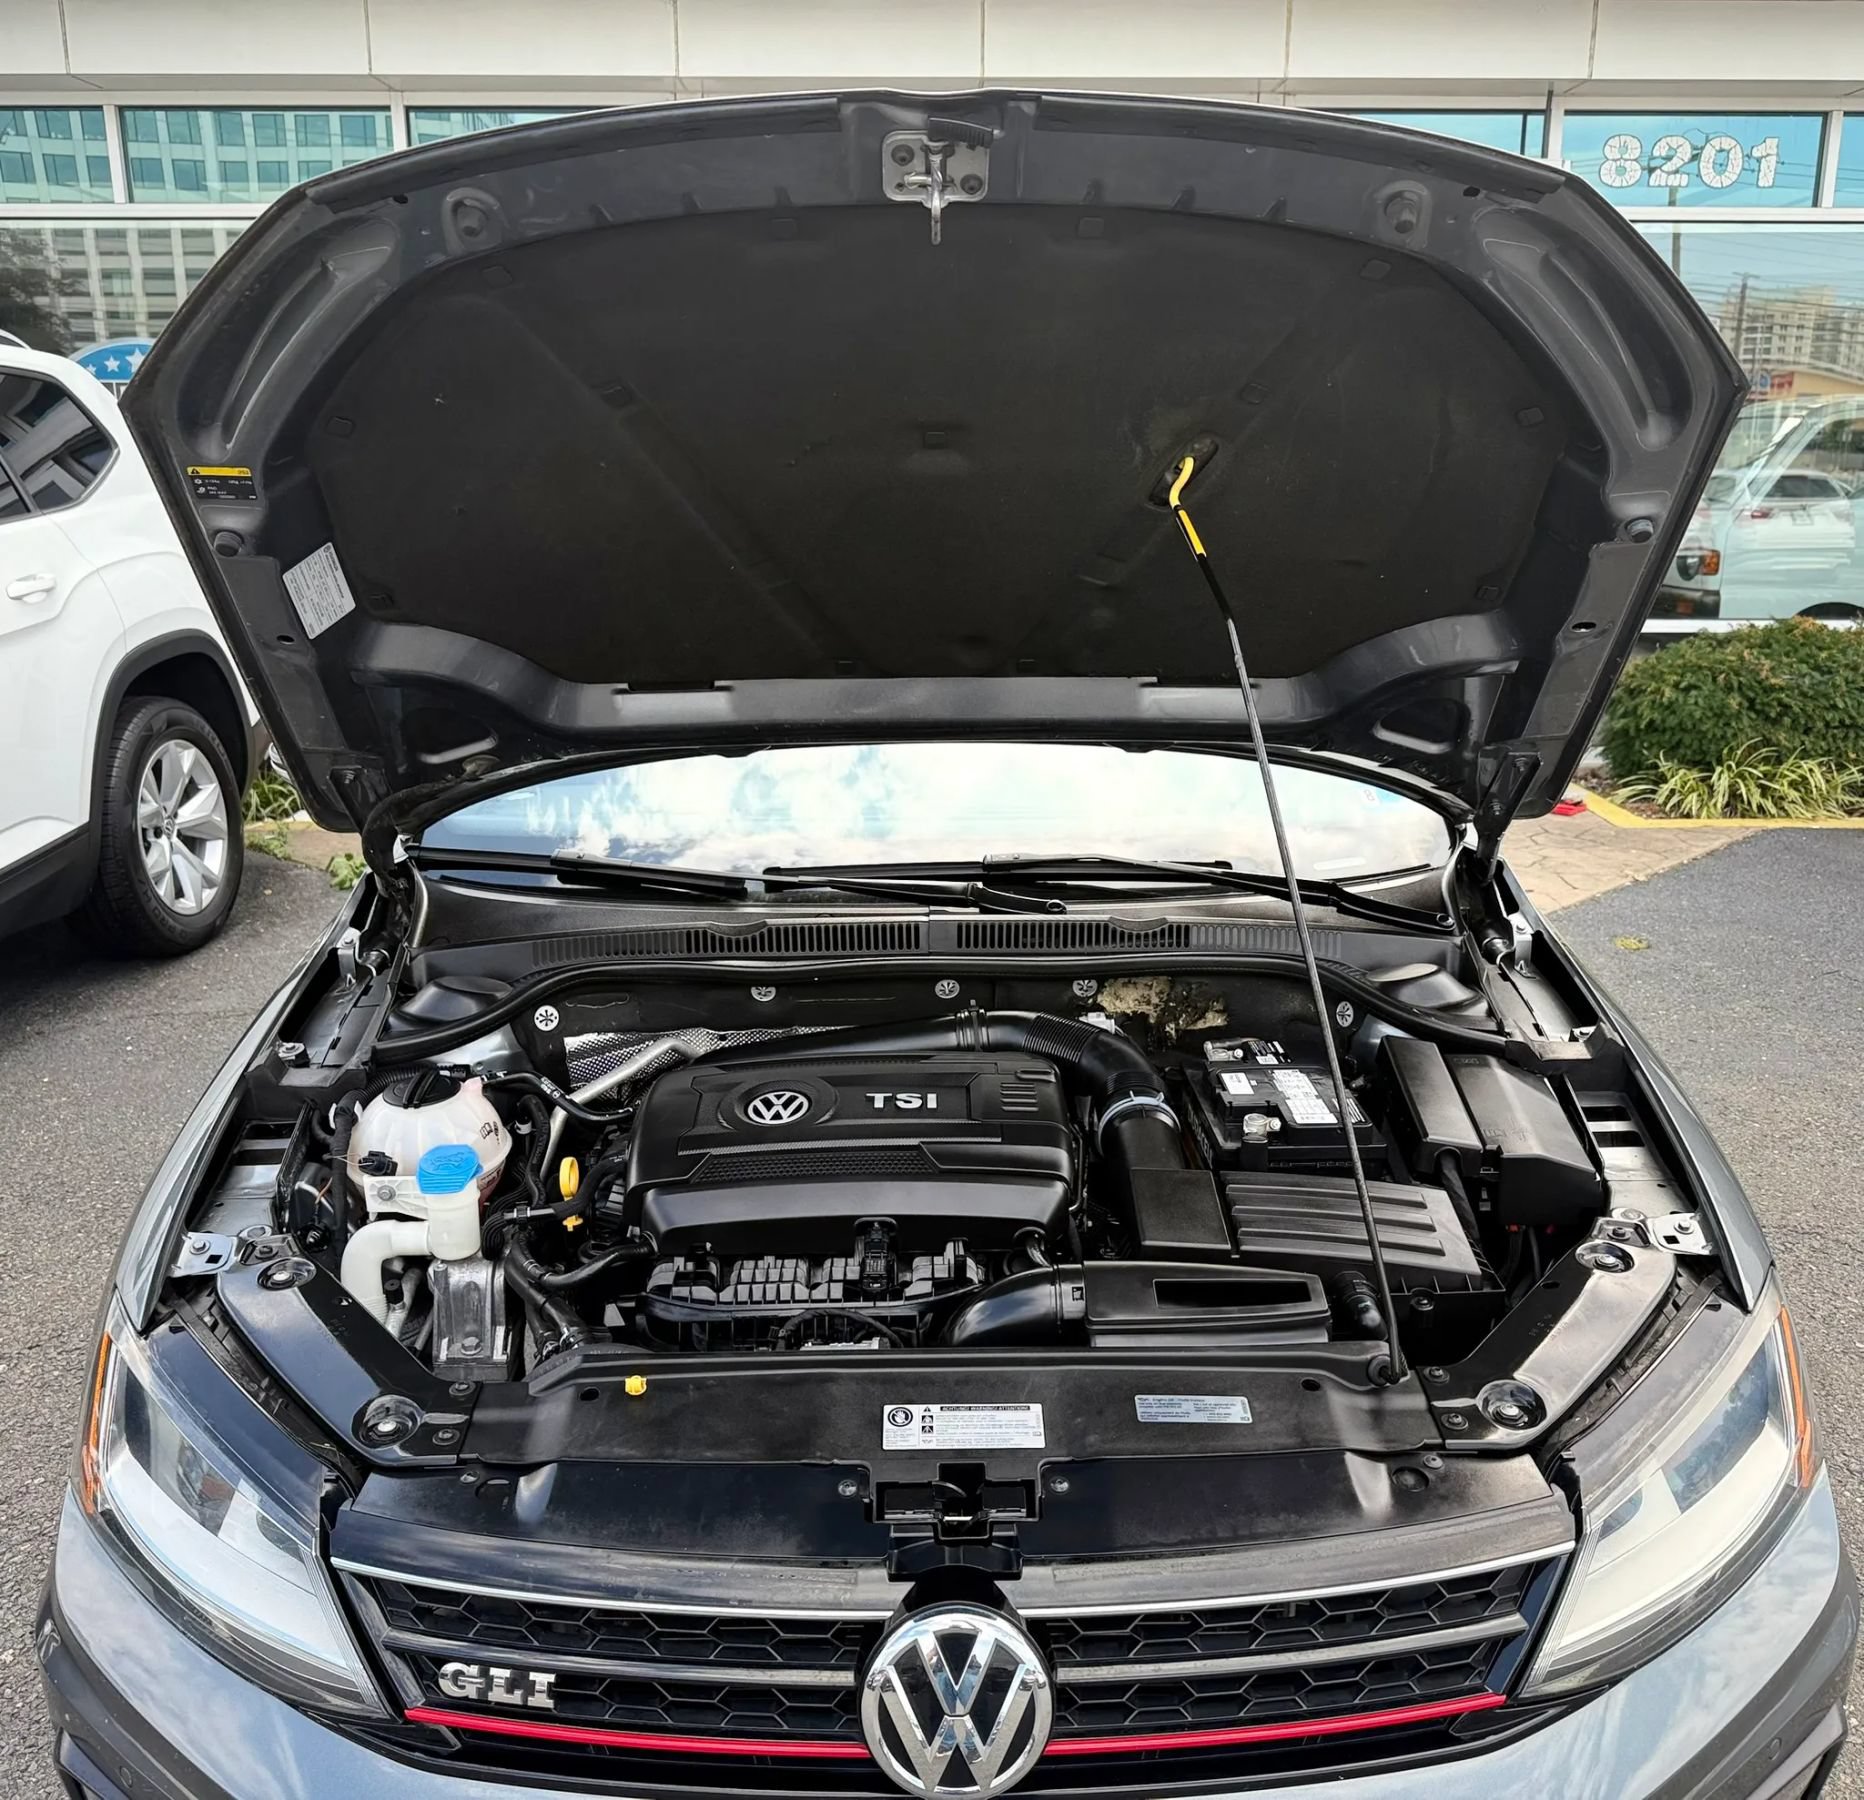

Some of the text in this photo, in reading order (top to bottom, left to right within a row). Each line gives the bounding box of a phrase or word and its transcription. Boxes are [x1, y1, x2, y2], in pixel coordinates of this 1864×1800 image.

[1598, 133, 1780, 189] 8201
[865, 1092, 938, 1109] TSI
[438, 1661, 557, 1709] GLI
